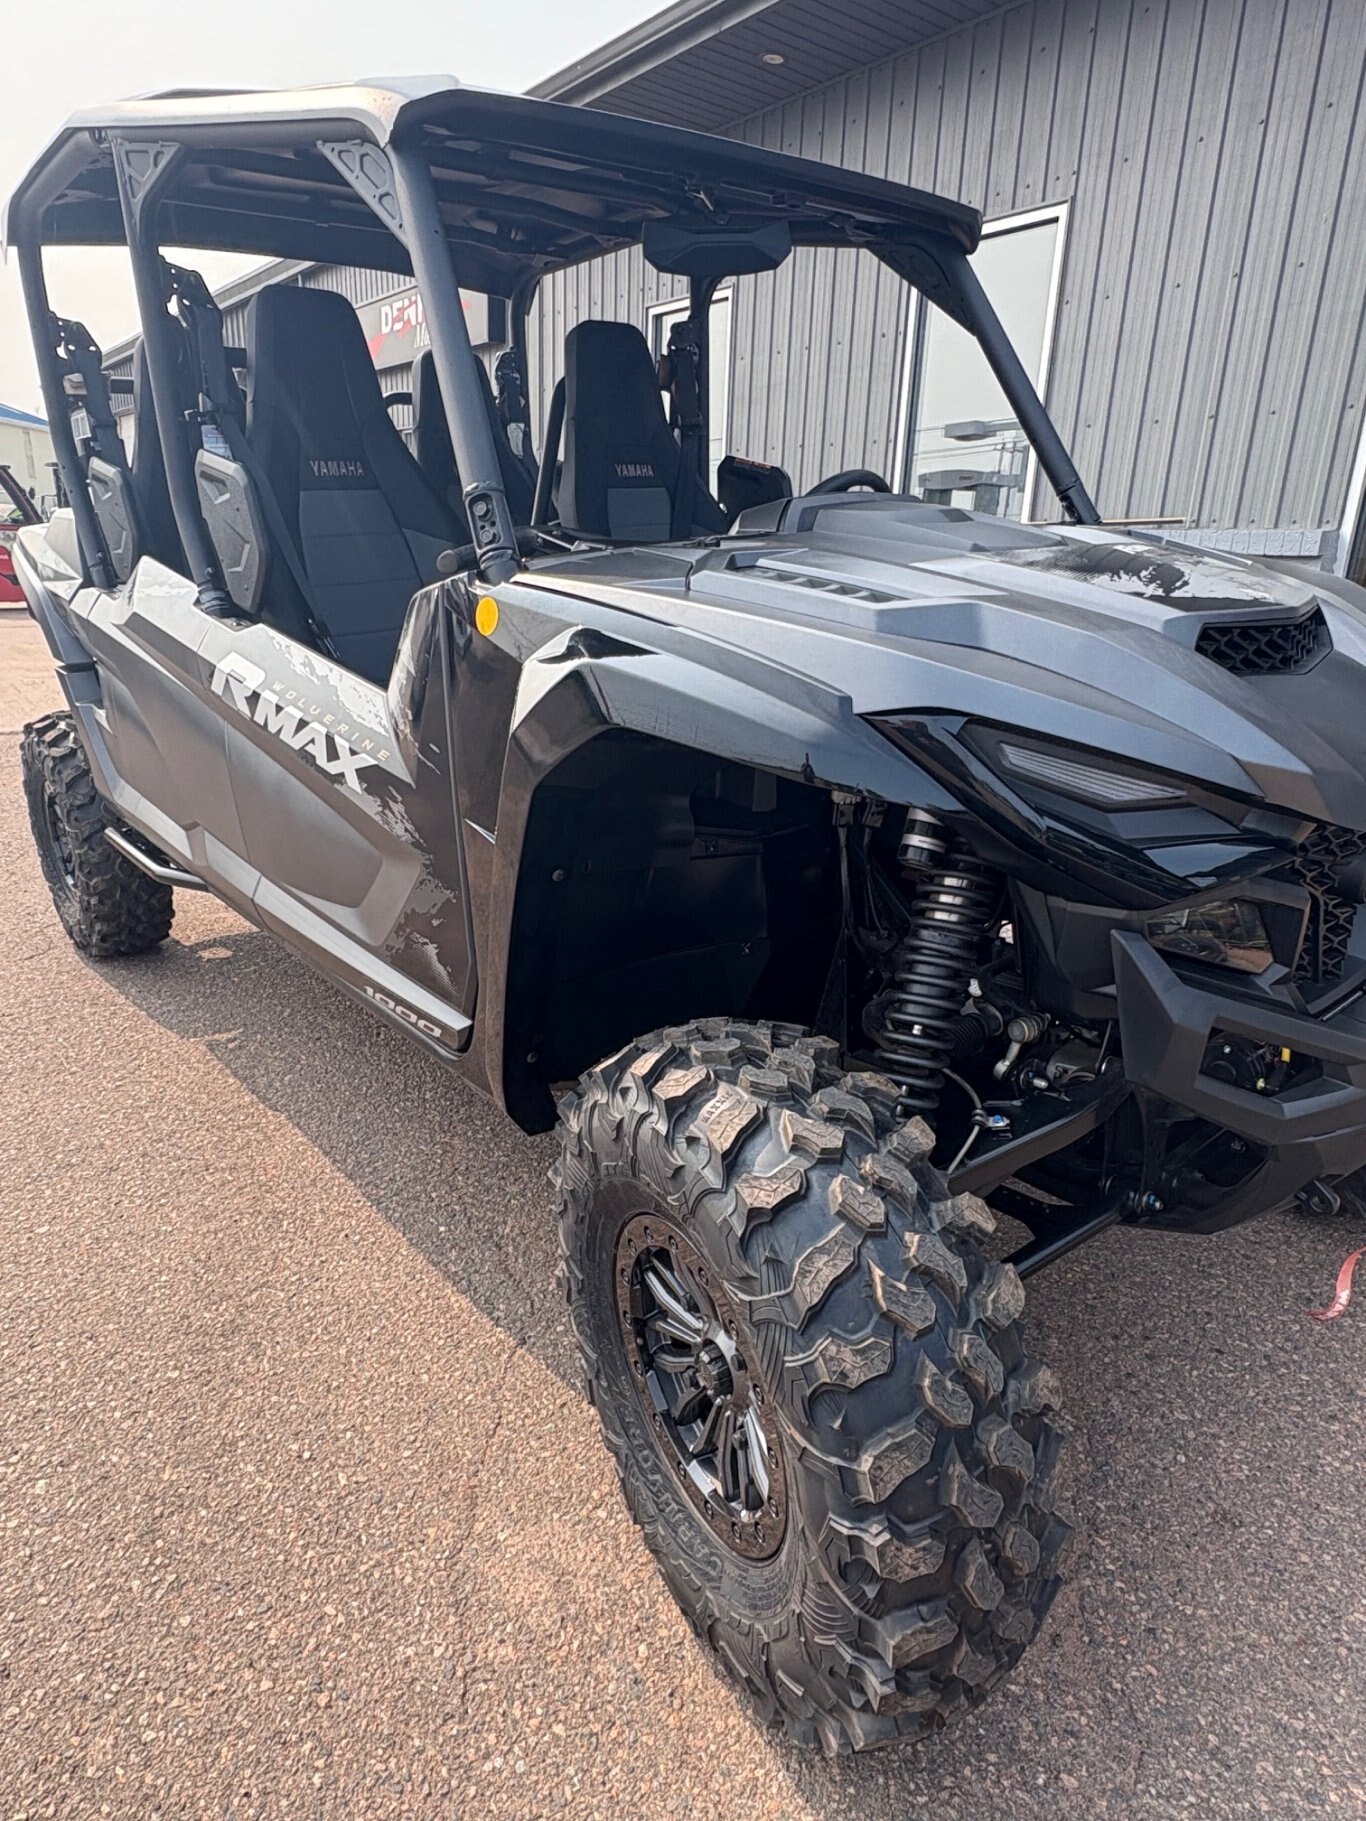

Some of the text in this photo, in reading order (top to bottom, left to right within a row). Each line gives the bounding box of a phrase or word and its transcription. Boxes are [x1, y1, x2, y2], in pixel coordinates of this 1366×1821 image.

[309, 460, 365, 476] YAMAHA
[614, 463, 655, 477] YAMAHA
[210, 651, 379, 795] RMAX
[272, 680, 391, 761] WOLVERINE
[363, 985, 442, 1038] 1000
